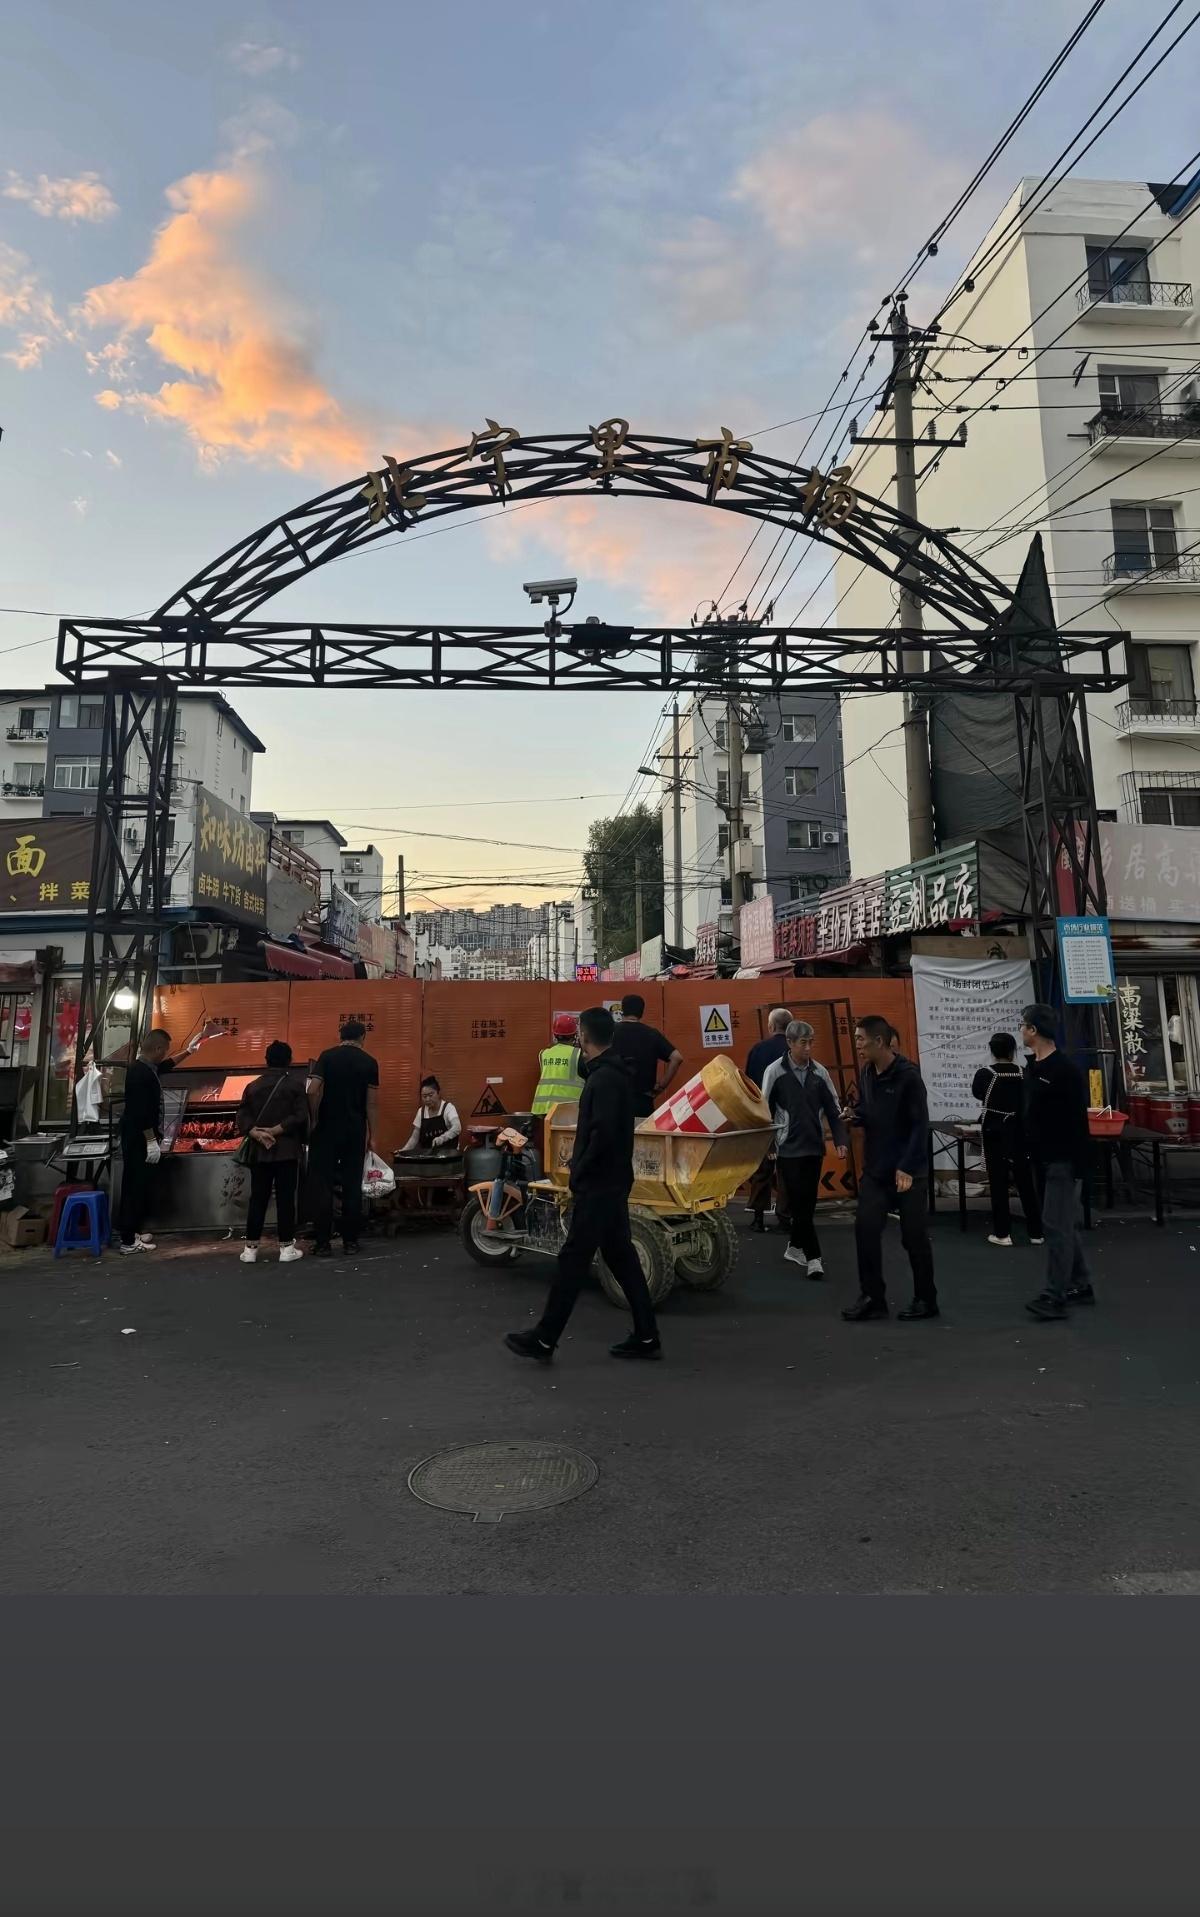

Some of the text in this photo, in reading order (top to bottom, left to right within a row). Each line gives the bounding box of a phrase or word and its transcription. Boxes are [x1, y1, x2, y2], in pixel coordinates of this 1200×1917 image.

[6, 834, 47, 878] 面
[888, 864, 974, 933] 豆制品店
[815, 895, 883, 951] 平价水果店
[943, 979, 1009, 990] 市场封闭告知书
[471, 1019, 506, 1029] 正在施工
[471, 1029, 506, 1038] 注意安全
[704, 1033, 730, 1042] 注意安全
